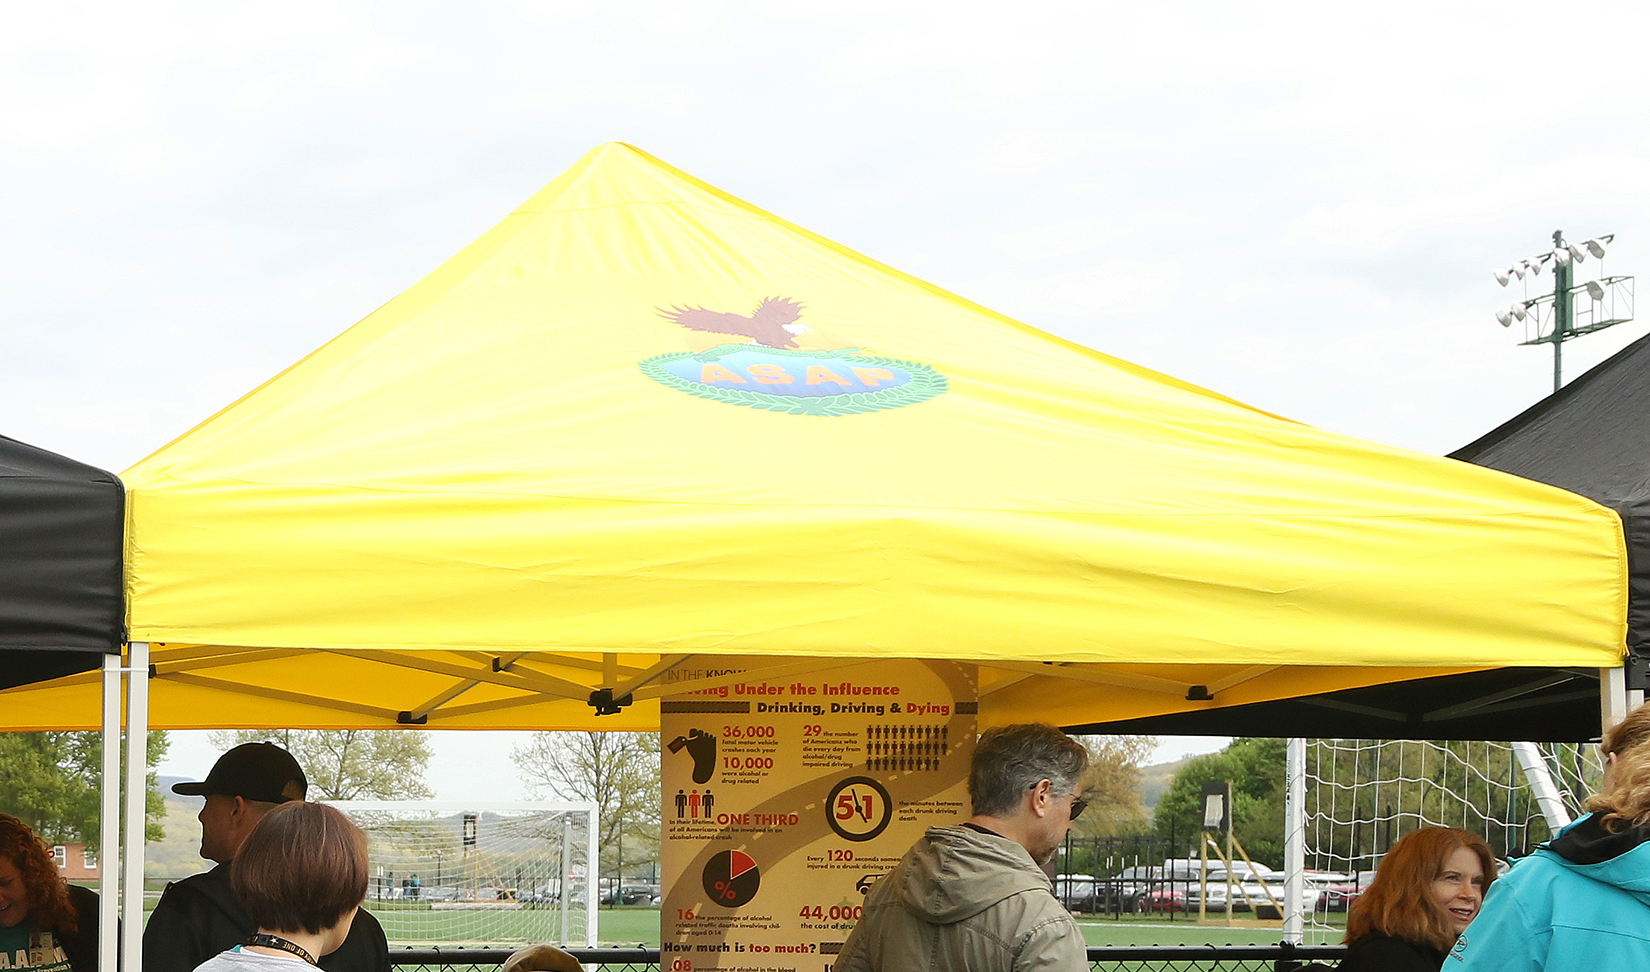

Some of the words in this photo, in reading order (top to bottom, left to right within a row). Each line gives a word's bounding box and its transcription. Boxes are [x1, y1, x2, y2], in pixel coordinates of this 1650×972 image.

[699, 363, 896, 388] ASAP
[668, 670, 680, 680] IN
[683, 669, 703, 680] THE
[734, 682, 785, 695] Under
[790, 682, 817, 695] the
[822, 682, 900, 695] Influence
[757, 702, 826, 716] Drinking,
[831, 702, 885, 716] Driving
[890, 702, 902, 713] &
[907, 702, 950, 716] Dying
[723, 726, 775, 739] 36,000
[803, 725, 822, 737] 29
[723, 757, 774, 770] 10,000
[803, 753, 842, 761] alcohol/drug
[803, 761, 830, 769] impaired
[831, 761, 853, 769] driving
[835, 795, 873, 821] 51
[717, 813, 750, 826] ONE
[754, 813, 799, 826] THIRD
[807, 855, 824, 863] Every
[827, 850, 854, 862] 120
[677, 909, 695, 921] 16
[799, 905, 863, 922] 44,000
[282, 941, 296, 952] ONE
[664, 942, 692, 953] How
[696, 942, 730, 953] much
[735, 942, 745, 953] is
[749, 943, 770, 953] too
[774, 943, 817, 953] much?
[669, 960, 692, 972] .08
